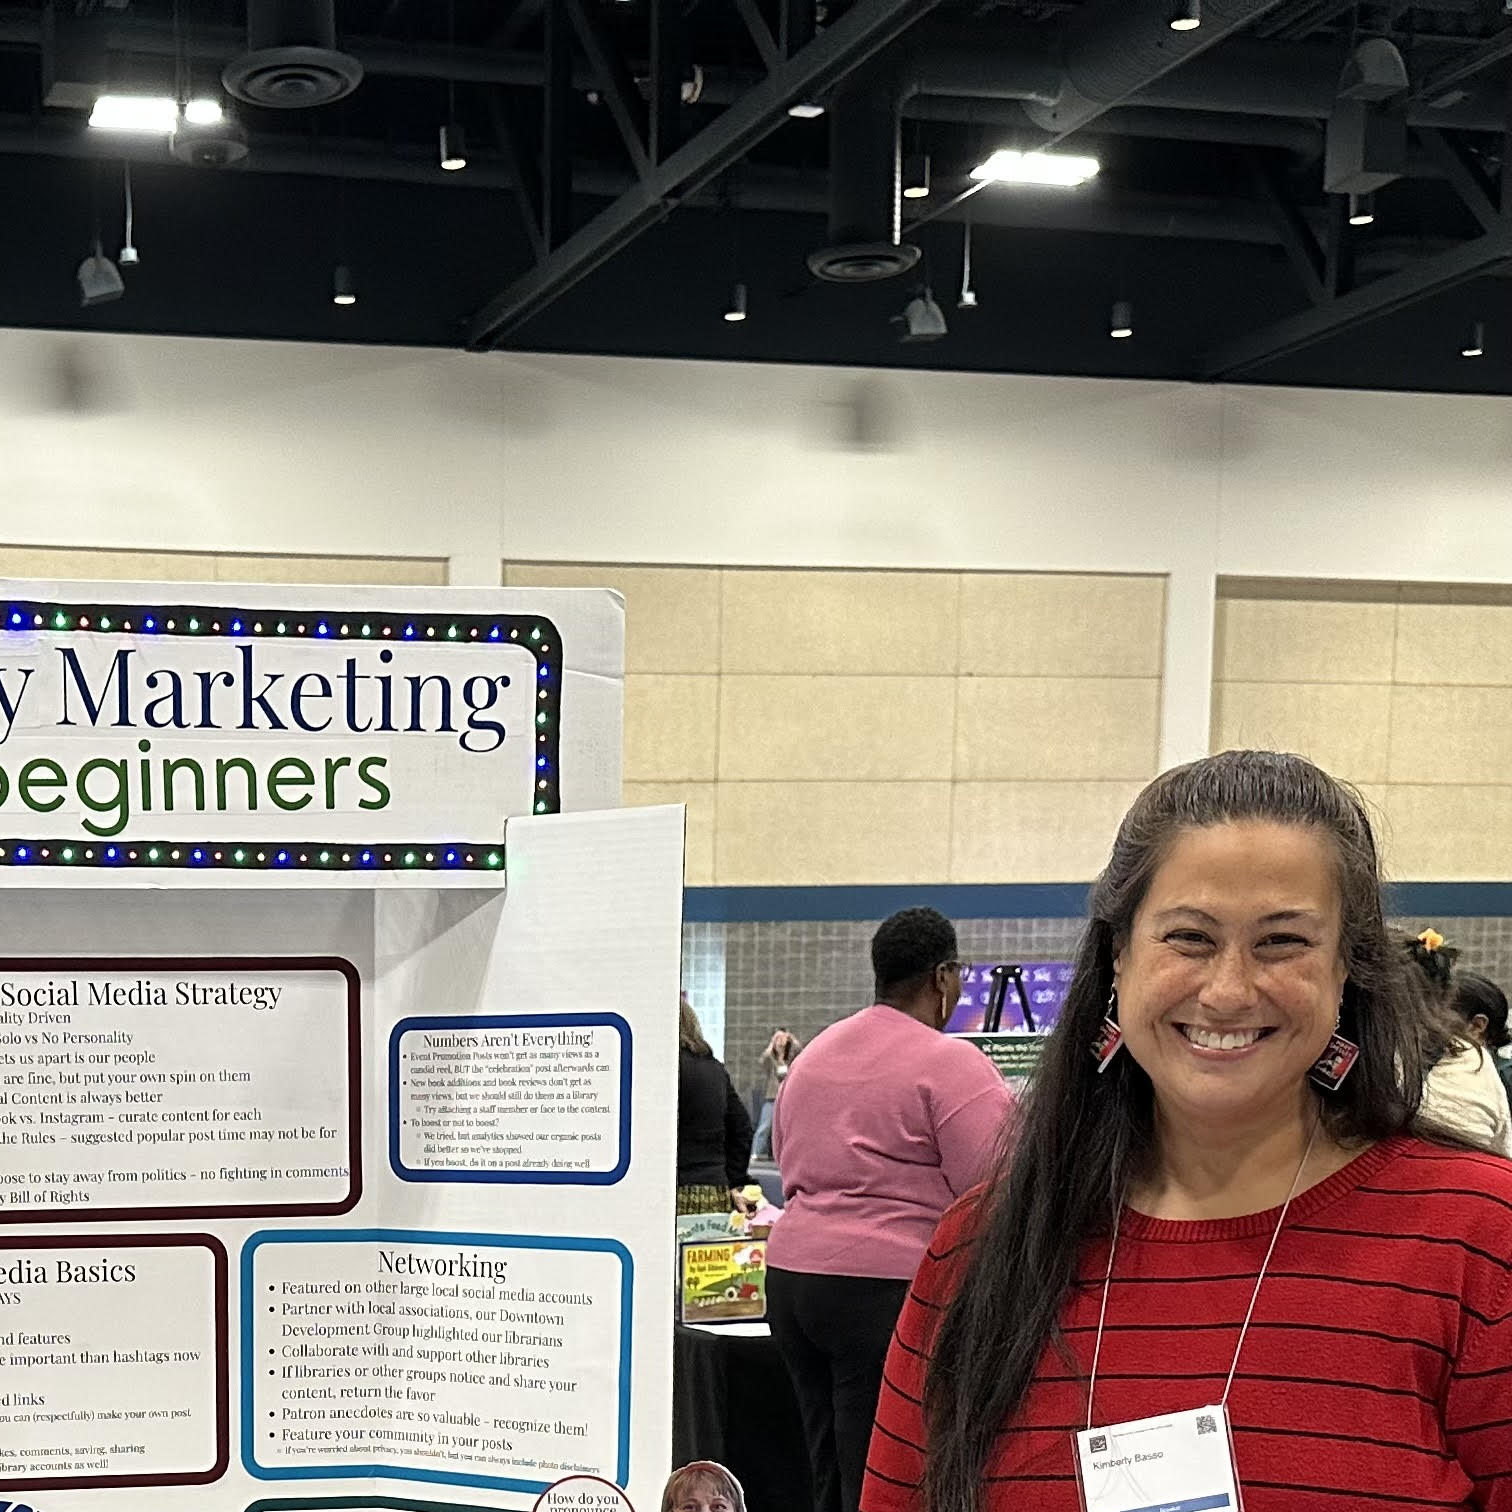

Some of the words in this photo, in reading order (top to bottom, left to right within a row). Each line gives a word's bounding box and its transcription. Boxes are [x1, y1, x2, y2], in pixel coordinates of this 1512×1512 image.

[56, 647, 511, 753] Marketing
[1, 980, 79, 1007] Social
[88, 980, 168, 1006] Media
[176, 982, 282, 1010] Strategy
[28, 1011, 71, 1024] Driven
[24, 1035, 38, 1045] vs
[42, 1032, 59, 1045] No
[63, 1030, 133, 1046] Personality
[423, 1034, 479, 1049] Numbers
[481, 1033, 519, 1047] Aren't
[522, 1031, 594, 1049] Everything!
[19, 1055, 34, 1065] us
[37, 1052, 71, 1066] apart
[74, 1051, 85, 1064] is
[88, 1054, 111, 1064] our
[113, 1050, 155, 1065] people
[10, 1190, 30, 1204] Bill
[34, 1190, 47, 1203] of
[50, 1190, 90, 1205] Rights
[687, 1248, 730, 1264] FARMING
[56, 1258, 136, 1283] Basics
[378, 1250, 508, 1284] Networking
[281, 1281, 341, 1295] Featured
[344, 1283, 362, 1294] on
[365, 1284, 398, 1294] other
[400, 1285, 429, 1298] large
[432, 1287, 459, 1297] local
[462, 1288, 495, 1300] social
[498, 1290, 535, 1302] media
[538, 1292, 593, 1306] accounts
[1092, 1456, 1132, 1470] Kimberly
[1134, 1451, 1164, 1463] Basso
[547, 1493, 575, 1505] How
[578, 1493, 594, 1505] do
[596, 1495, 619, 1507] you
